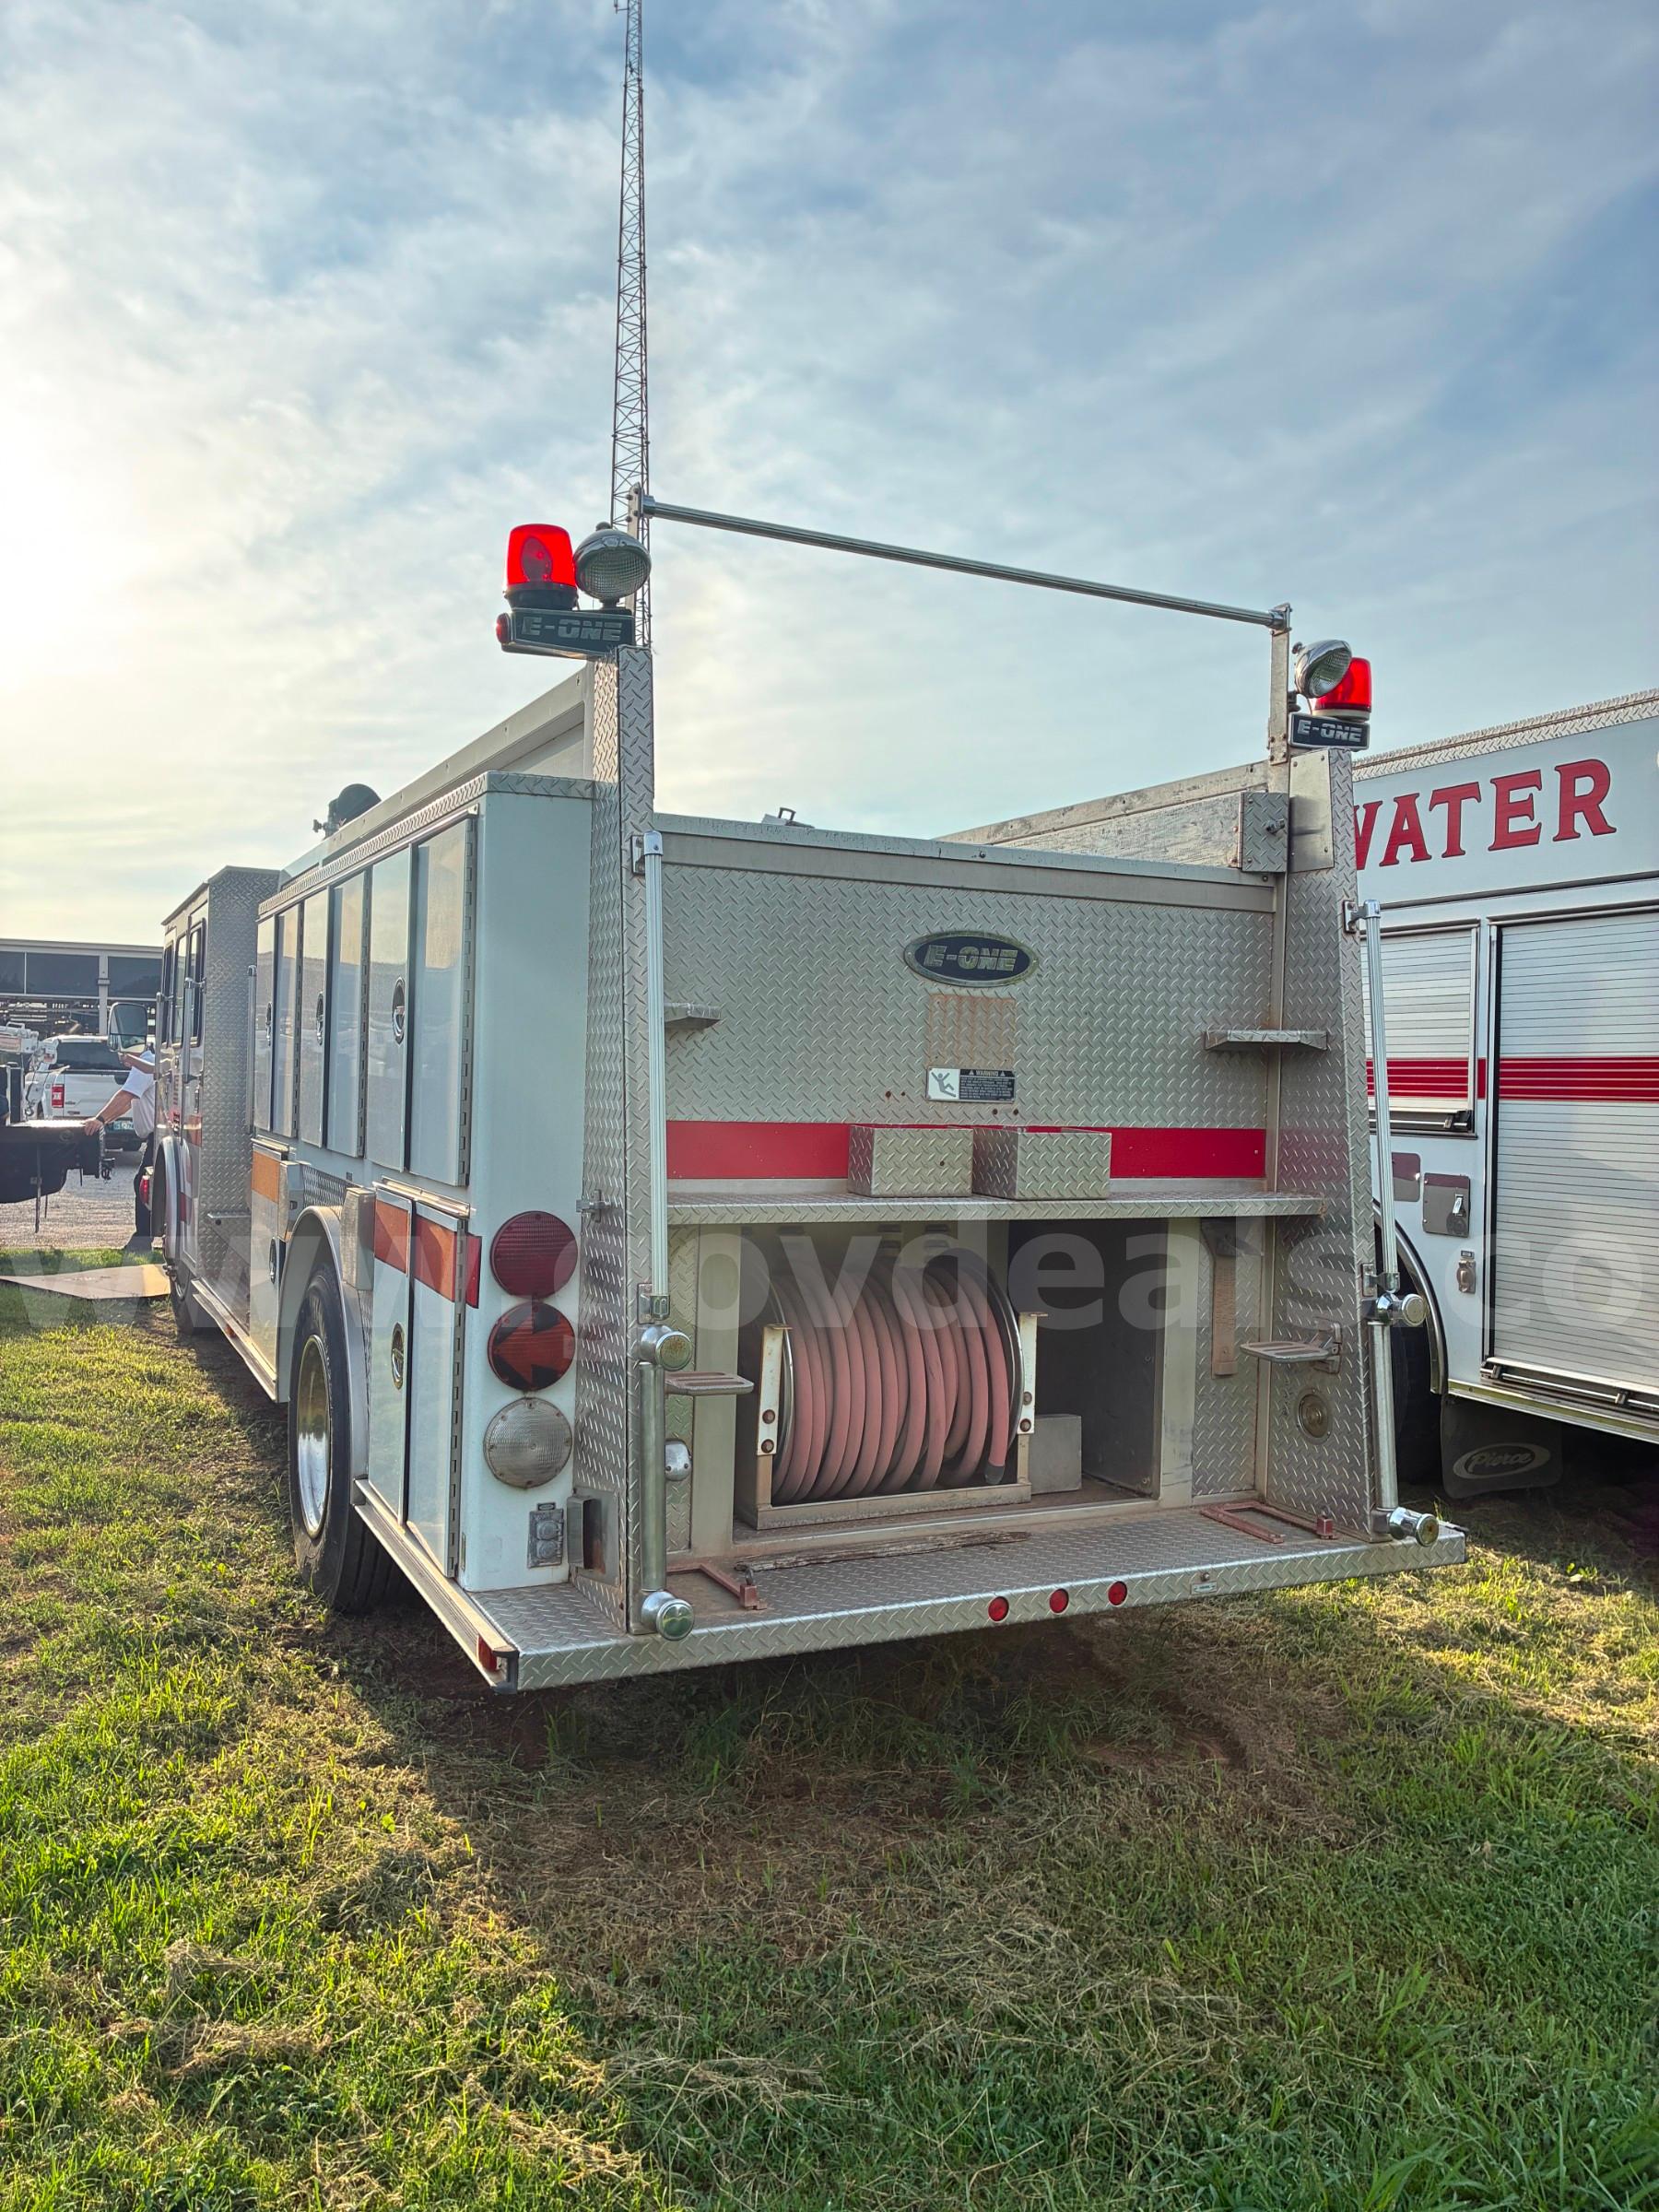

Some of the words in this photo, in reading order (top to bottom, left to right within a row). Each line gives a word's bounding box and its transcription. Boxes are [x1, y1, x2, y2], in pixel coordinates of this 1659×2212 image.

[521, 616, 623, 642] E-ONE
[1297, 719, 1363, 743] E-ONE
[923, 945, 1018, 971] E-ONE
